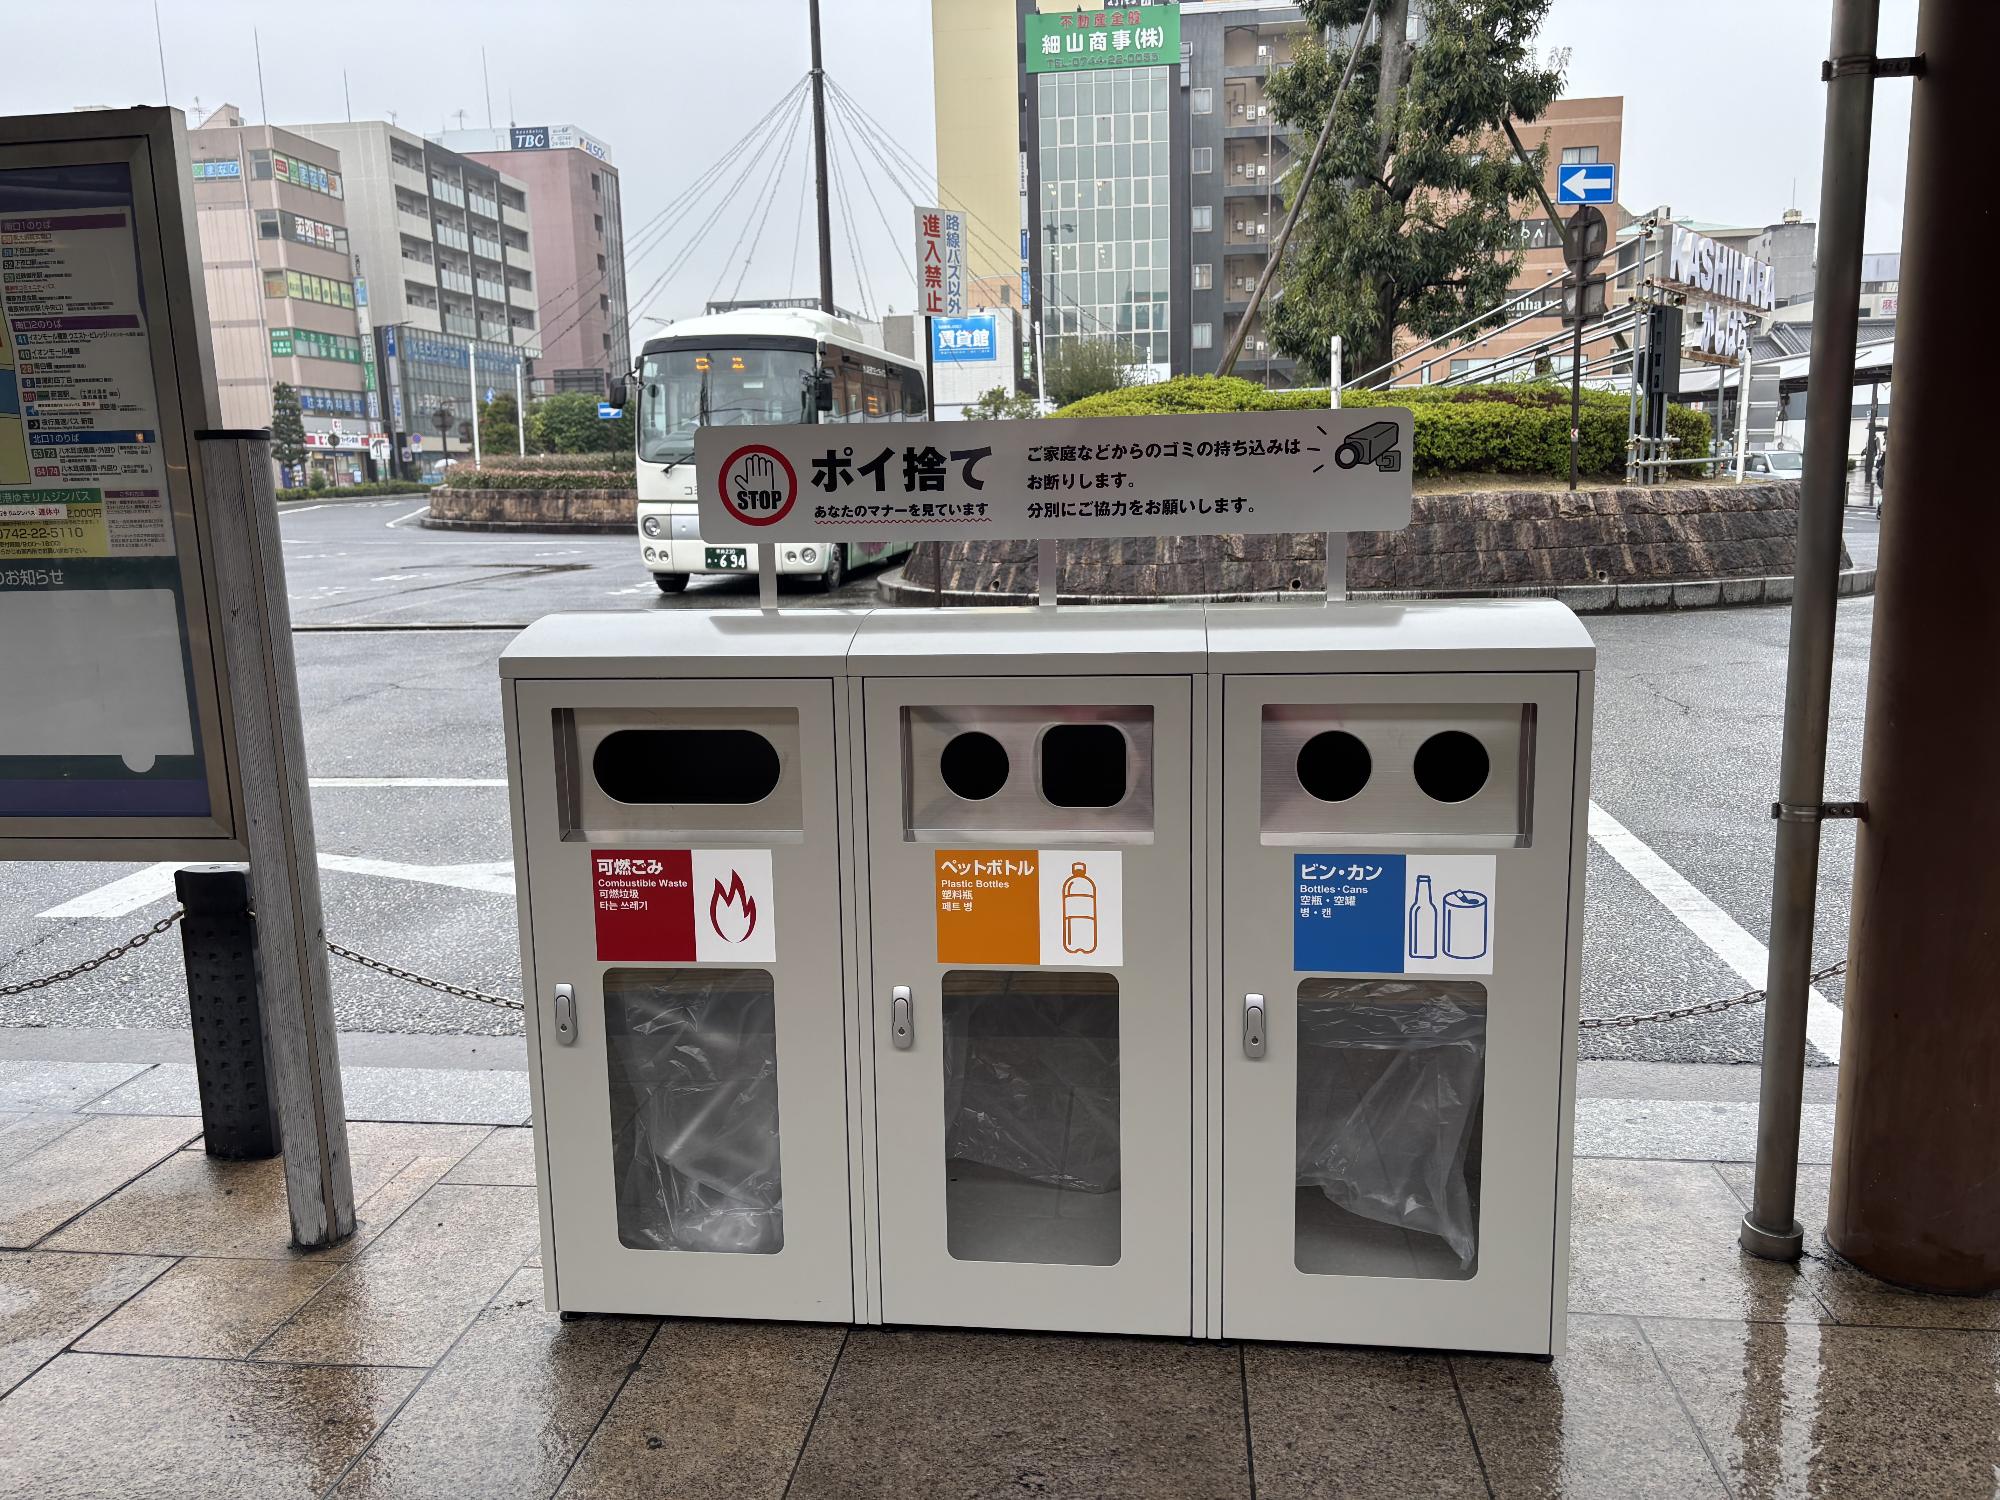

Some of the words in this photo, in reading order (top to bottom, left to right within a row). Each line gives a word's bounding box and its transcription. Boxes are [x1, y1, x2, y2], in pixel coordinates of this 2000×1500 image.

[1041, 26, 1164, 54] 細山商事(株)
[515, 134, 544, 148] TBC
[922, 214, 943, 313] 進入禁止
[946, 214, 961, 314] 路線バス以外
[1669, 223, 1776, 312] KASHIHARA
[33, 434, 80, 443] 北口1のりば
[1026, 439, 1301, 462] ご家庭などからのゴミの持ち込みは
[810, 446, 992, 492] ポイ捨て
[1026, 472, 1136, 490] お断りします。
[737, 490, 782, 510] STOP
[1027, 497, 1256, 519] 分別にご協力をお願いします。
[814, 503, 989, 518] あなたのマナーを見ています
[597, 859, 664, 876] 可燃ごみ
[941, 859, 1035, 876] ペットボトル
[1301, 863, 1383, 880] ビン・カン
[598, 879, 657, 888] Combustible
[659, 879, 688, 888] Waste
[941, 880, 973, 888] Plastic
[976, 880, 1010, 889] Bottles
[599, 889, 639, 899] 可燃垃圾
[941, 889, 973, 900] 塑料瓶
[600, 901, 618, 911] 타는
[621, 901, 648, 911] 쓰레기
[942, 902, 961, 911] 페트
[964, 902, 973, 911] 병
